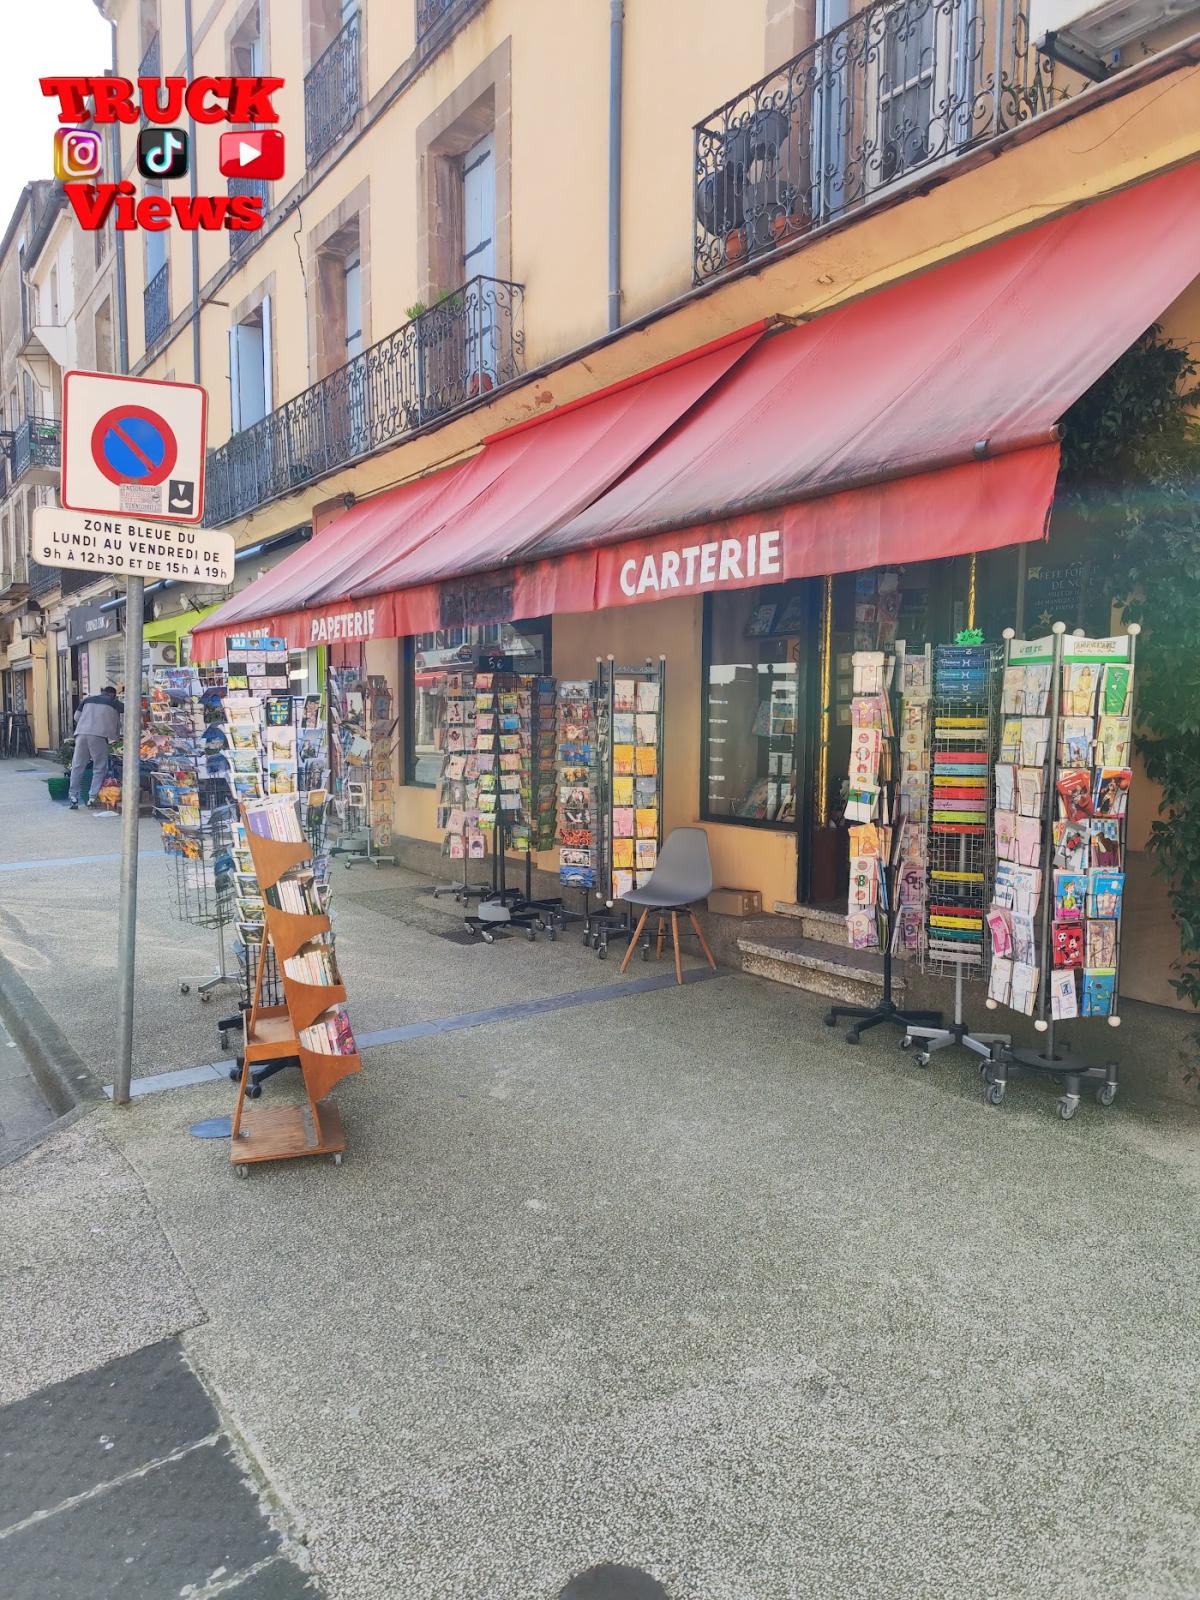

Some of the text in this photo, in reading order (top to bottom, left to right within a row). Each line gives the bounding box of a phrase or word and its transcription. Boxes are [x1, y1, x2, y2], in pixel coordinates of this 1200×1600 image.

[53, 531, 220, 563] LUNDI AU VENDREDI DE
[84, 519, 195, 544] ZONE BLEUE DU
[43, 547, 227, 580] 9h À 12h30 ET DE 15h À 19h
[619, 530, 780, 597] CARTERIE
[311, 608, 375, 642] PAPETERIE
